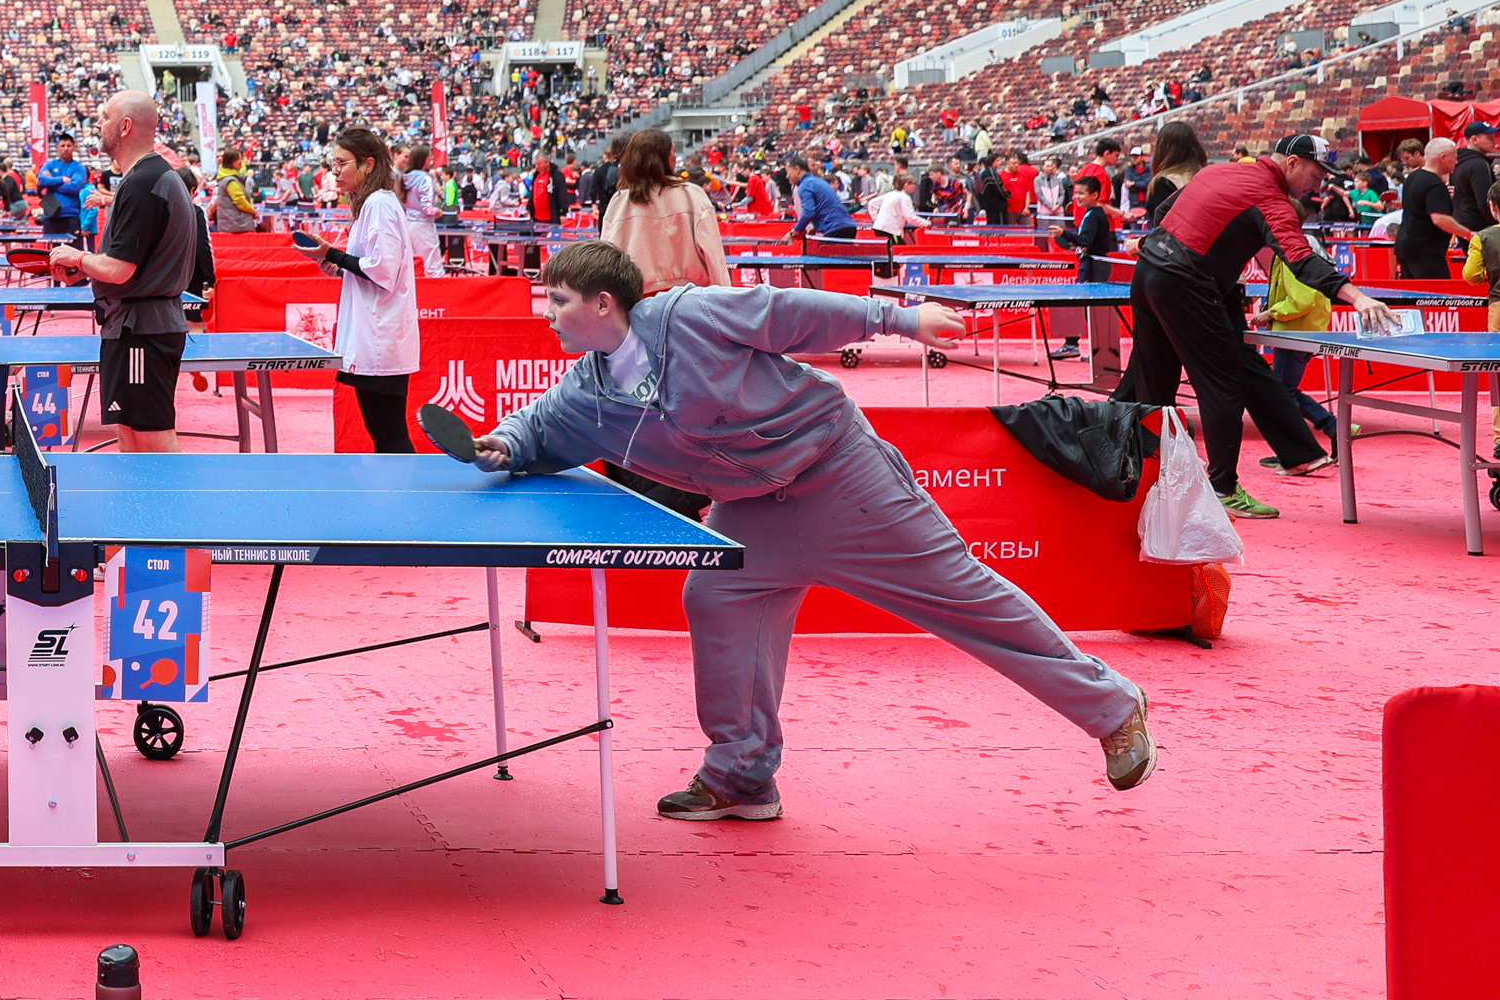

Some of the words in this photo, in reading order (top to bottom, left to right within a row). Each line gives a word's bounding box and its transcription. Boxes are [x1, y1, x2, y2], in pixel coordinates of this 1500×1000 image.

[159, 51, 177, 59] 120
[192, 50, 209, 58] 119
[522, 48, 540, 56] 118
[556, 48, 574, 56] 117
[1339, 254, 1350, 265] 10
[974, 301, 1010, 309] START
[1416, 299, 1444, 307] COMPACT
[1444, 299, 1474, 307] OUTDOOR
[1318, 345, 1344, 356] START
[246, 359, 298, 371] START
[1460, 362, 1500, 372] STAR
[31, 392, 57, 415] 44
[233, 549, 270, 561] ТЕННИС
[270, 549, 277, 561] В
[278, 549, 311, 561] ШКОЛЕ
[969, 540, 1040, 560] сквы
[545, 548, 622, 566] COMPACT
[622, 549, 699, 568] OUTDOOR
[700, 550, 725, 567] LX
[147, 559, 170, 571] СТОЛ
[132, 599, 179, 641] 42
